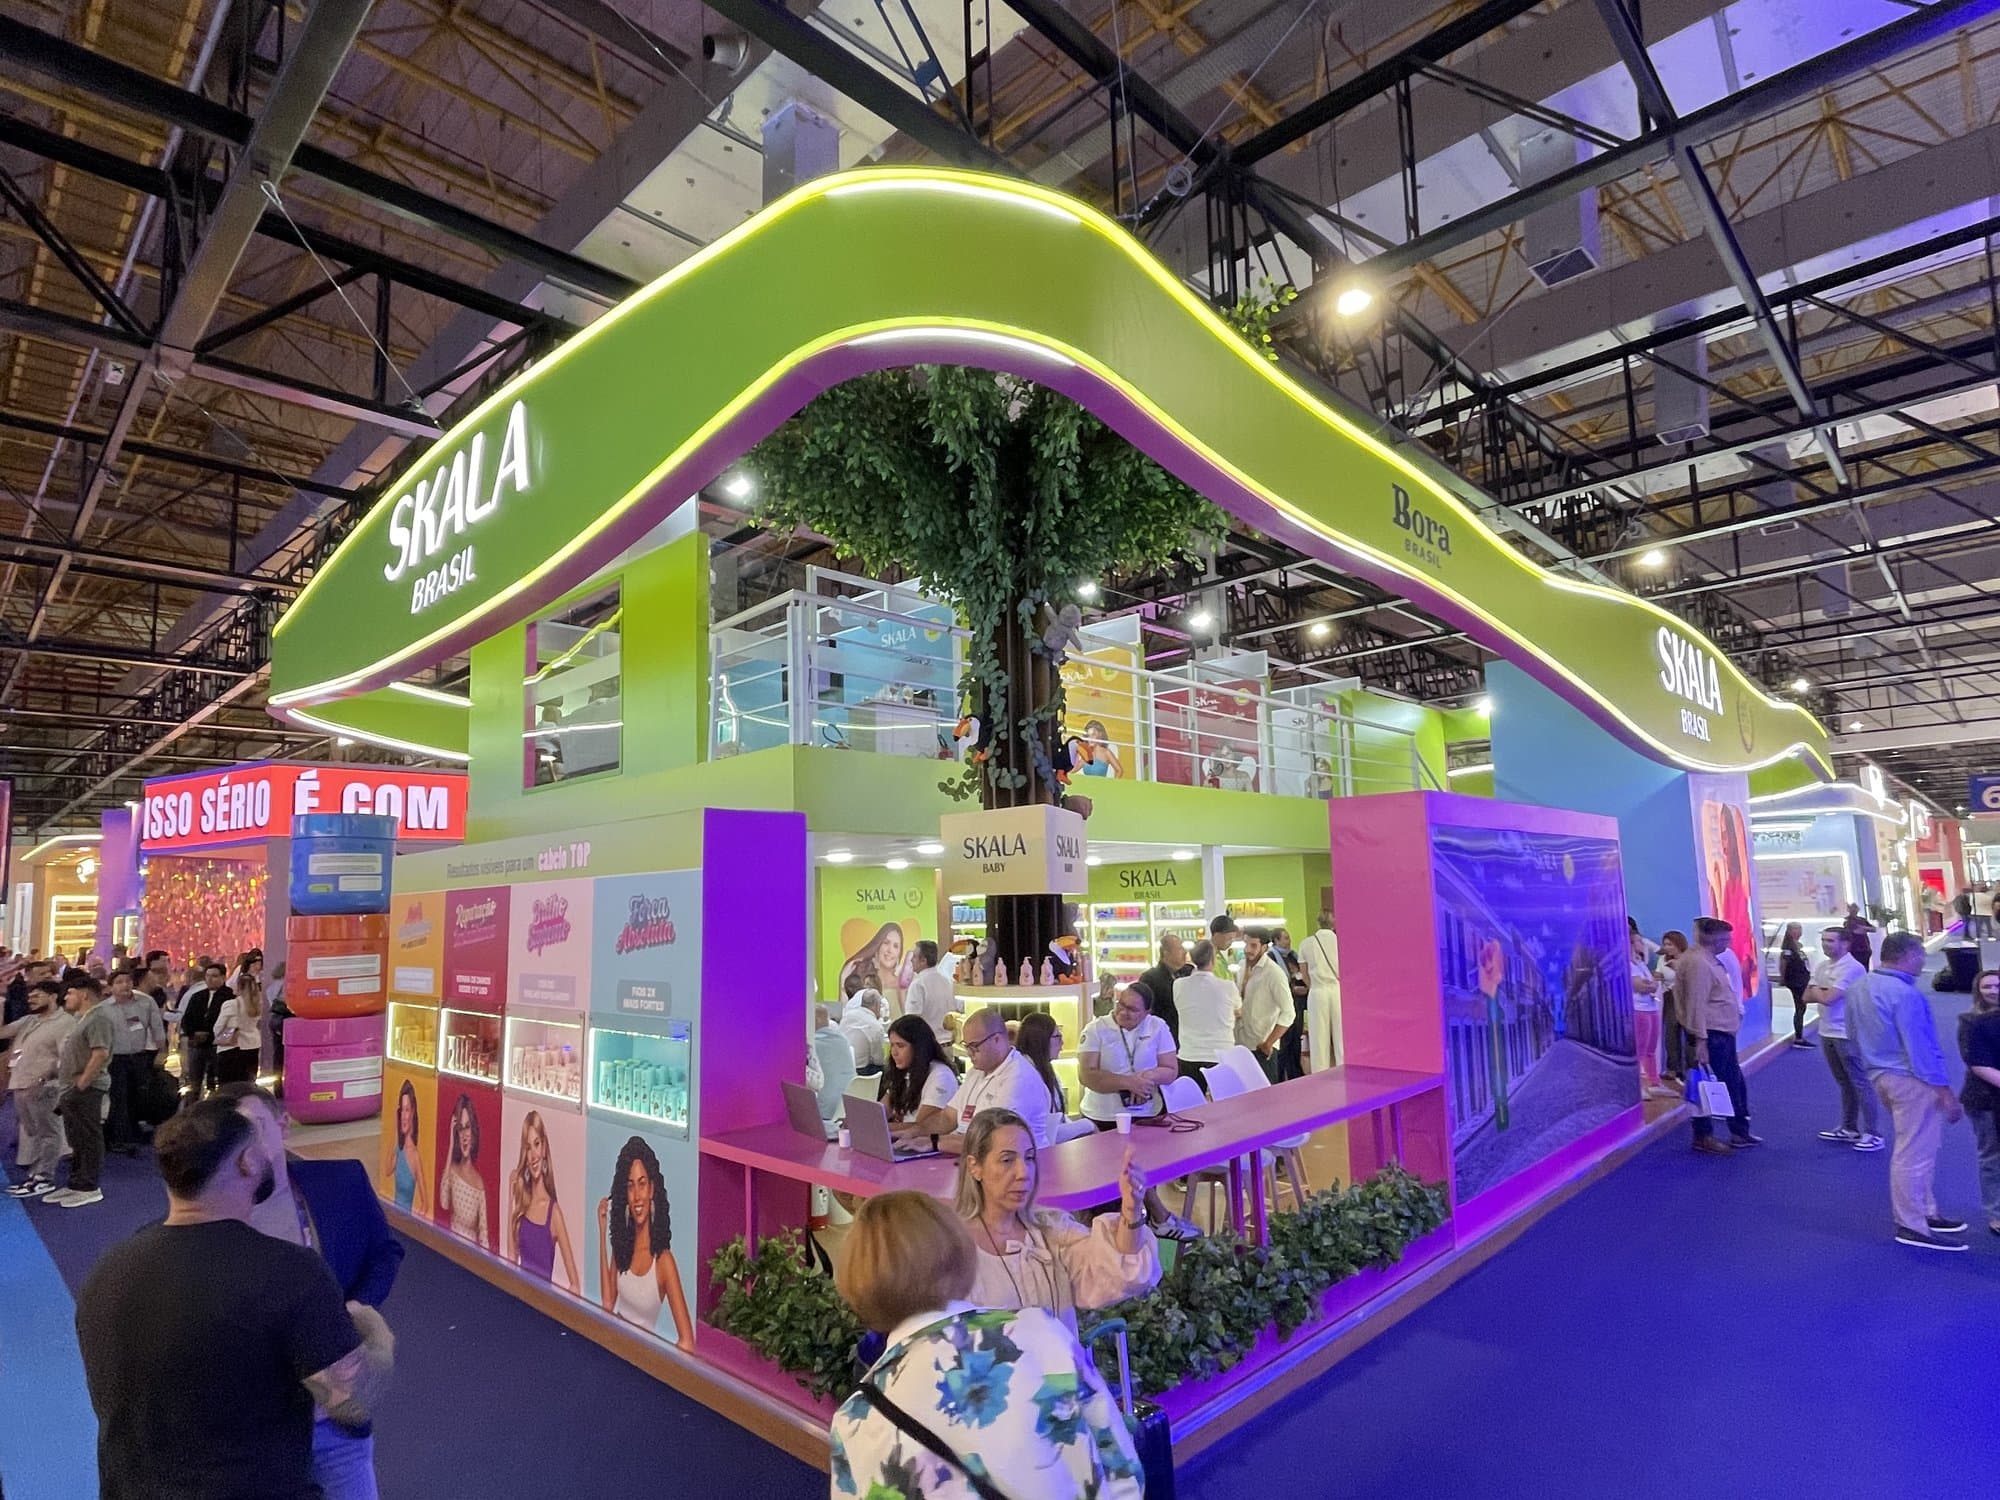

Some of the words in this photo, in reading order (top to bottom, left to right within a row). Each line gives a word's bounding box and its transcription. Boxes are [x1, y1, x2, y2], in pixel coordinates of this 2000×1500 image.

[384, 400, 530, 582] SKALA
[1391, 483, 1452, 555] Bora
[1404, 538, 1442, 569] BRASIL
[411, 545, 477, 615] BRASIL
[1658, 626, 1724, 716] SKALA
[1680, 708, 1711, 742] BRASIL
[200, 774, 270, 833] SÉRIO
[342, 782, 448, 830] COM
[570, 841, 591, 869] TOP
[963, 832, 1027, 859] SKALA
[1056, 835, 1080, 859] SKALA
[982, 862, 1006, 874] BABY
[1119, 868, 1176, 888] SKALA
[629, 893, 670, 926] Força
[856, 888, 896, 903] SKALA
[1133, 891, 1160, 900] BRASIL
